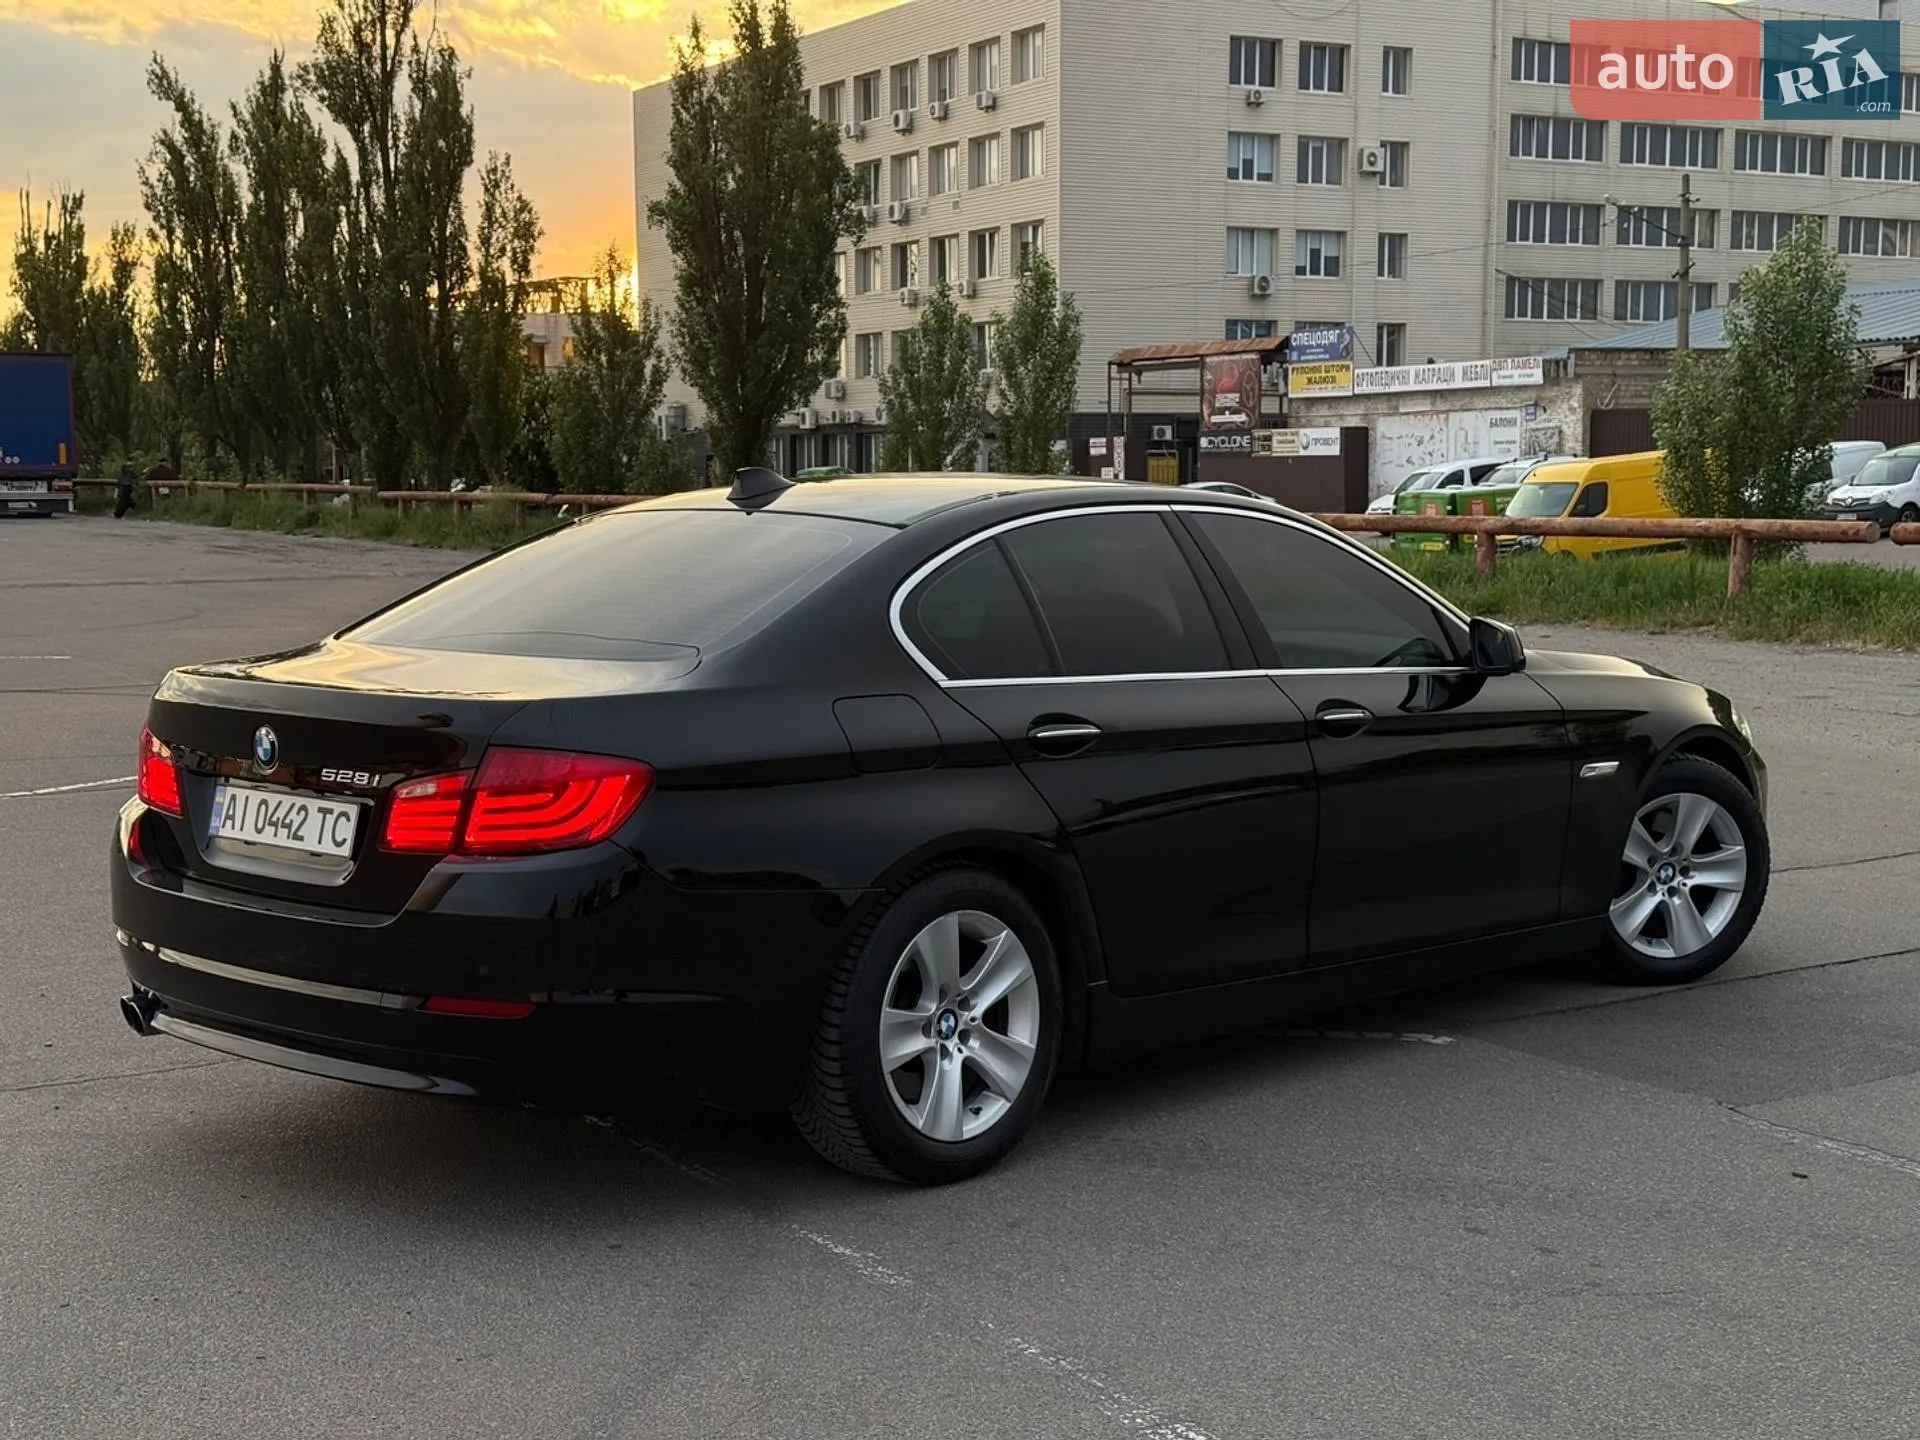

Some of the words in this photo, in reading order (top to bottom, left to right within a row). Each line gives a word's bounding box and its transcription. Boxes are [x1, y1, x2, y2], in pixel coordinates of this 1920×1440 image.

[1291, 330, 1340, 347] СПЕЦОДЯГ
[1356, 369, 1410, 390] ОРТОПЕДИЧНІ
[1414, 365, 1455, 386] МАТРАЦИ
[1462, 362, 1489, 381] МЕБЛІ
[1489, 416, 1517, 429] БАЛОНИ
[1207, 435, 1251, 447] CYCLONE
[222, 794, 249, 831] AI
[254, 799, 309, 842] 0442
[317, 806, 350, 848] TC
